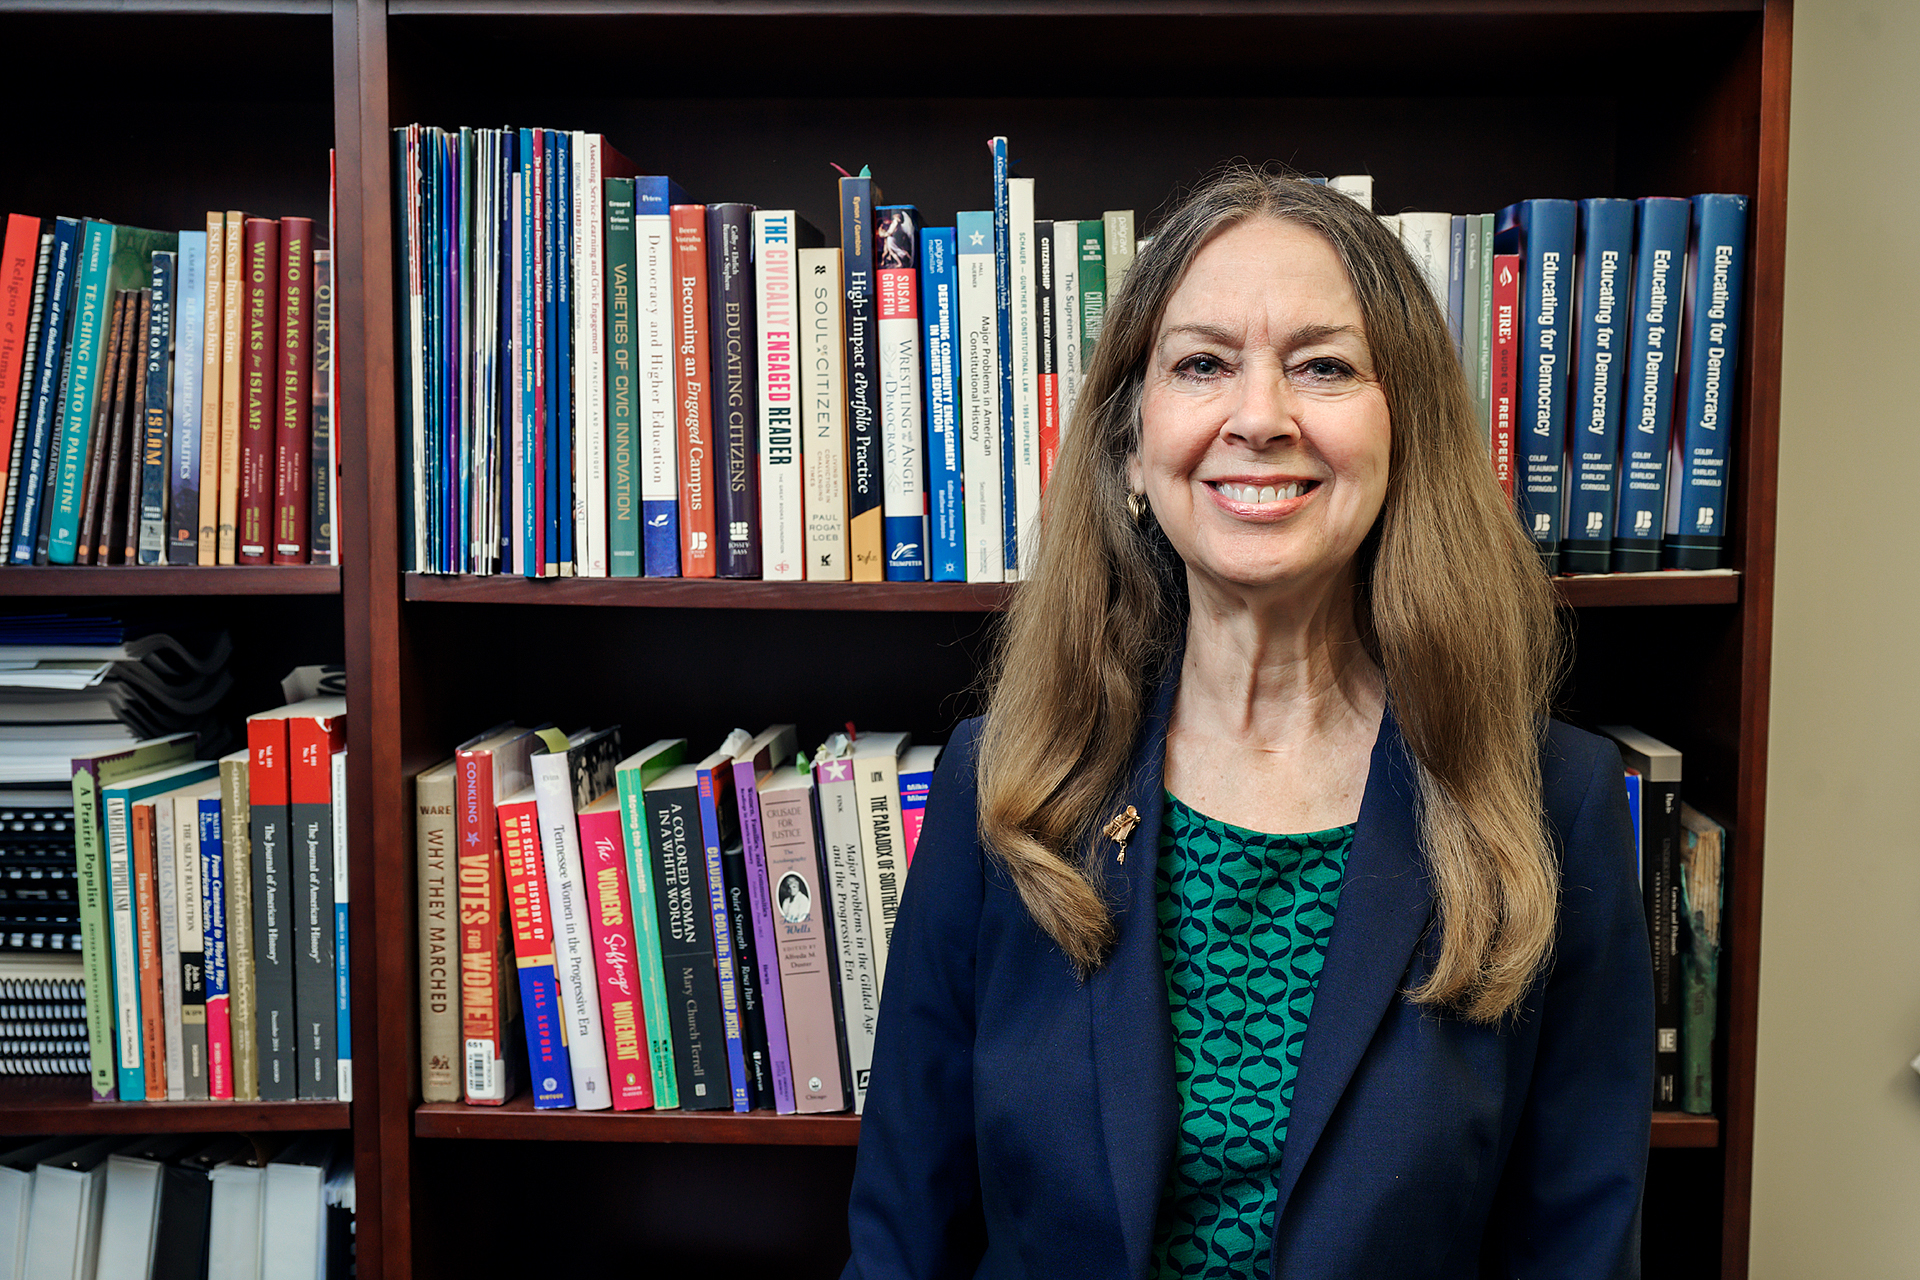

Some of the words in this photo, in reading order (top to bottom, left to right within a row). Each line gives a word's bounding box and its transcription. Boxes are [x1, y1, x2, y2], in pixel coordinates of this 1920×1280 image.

[588, 143, 597, 183] Assessing
[589, 185, 599, 257] Service-Learning
[764, 216, 787, 244] THE
[1118, 217, 1128, 255] palgrave
[288, 239, 300, 281] WHO
[591, 260, 599, 276] and
[646, 235, 662, 314] Democracy
[934, 239, 944, 273] palgrave
[1041, 237, 1050, 289] CITIZENSHIP
[591, 278, 599, 299] Civic
[614, 264, 628, 344] VARIETIES
[765, 250, 789, 326] CIVICALLY
[882, 273, 895, 315] GRIFFIN
[897, 275, 910, 312] SUSAN
[1538, 252, 1559, 325] Educating
[1595, 251, 1618, 324] Educating
[1646, 250, 1671, 322] Educating
[1708, 246, 1733, 319] Educating
[78, 284, 97, 361] TEACHING
[149, 266, 163, 372] ARMSTRONG
[286, 287, 300, 348] SPEAKS
[589, 303, 600, 354] Engagement
[651, 322, 663, 347] and
[681, 276, 697, 354] Becoming
[814, 287, 829, 343] SOUL
[851, 270, 869, 368] High-Impact
[930, 324, 940, 335] IN
[938, 284, 951, 340] DEEPENING
[980, 316, 991, 344] Major
[1499, 305, 1512, 343] FIRE's
[1710, 322, 1726, 344] for
[287, 353, 297, 366] for
[615, 349, 628, 370] OF
[725, 302, 742, 406] EDUCATING
[930, 337, 941, 371] HIGHER
[1540, 329, 1554, 350] for
[1596, 328, 1612, 349] for
[1648, 327, 1665, 348] for
[72, 365, 87, 412] PLATO
[648, 354, 664, 403] Higher
[685, 357, 697, 377] an
[767, 332, 790, 401] ENGAGED
[899, 338, 913, 428] WRESTLING
[940, 342, 953, 404] COMMUNITY
[969, 331, 982, 400] Constitutional
[983, 349, 991, 394] Problems
[1501, 382, 1508, 394] TO
[1700, 348, 1725, 430] Democracy
[285, 370, 297, 428] ISLAM?
[616, 376, 629, 416] CIVIC
[685, 381, 704, 444] Engaged
[816, 358, 830, 437] CITIZEN
[852, 372, 871, 431] ePortfolio
[932, 373, 943, 432] EDUCATION
[984, 398, 992, 406] in
[1045, 398, 1052, 406] TO
[1498, 397, 1508, 428] FREE
[1534, 354, 1553, 436] Democracy
[1589, 352, 1611, 435] Democracy
[1638, 352, 1663, 434] Democracy
[70, 416, 82, 433] IN
[145, 408, 163, 465] ISLAM
[769, 407, 792, 465] READER
[885, 381, 898, 464] DEMOCRACY
[943, 405, 956, 471] ENGAGEMENT
[969, 404, 983, 442] History
[984, 409, 993, 456] American
[652, 411, 665, 483] Education
[729, 411, 746, 491] CITIZENS
[856, 436, 871, 493] Practice
[901, 445, 914, 496] ANGEL
[1498, 433, 1509, 480] SPEECH
[60, 437, 80, 513] PALESTINE
[616, 422, 630, 520] INNOVATION
[687, 447, 703, 510] Campus
[80, 787, 91, 796] A
[420, 806, 451, 815] WARE
[466, 762, 478, 823] CONKLING
[671, 803, 682, 813] A
[871, 795, 887, 811] THE
[81, 802, 94, 850] Prairie
[108, 799, 126, 856] AMERICAN
[183, 823, 191, 839] THE
[520, 814, 531, 834] THE
[659, 809, 668, 823] IN
[661, 825, 671, 838] A
[872, 814, 893, 858] PARADOX
[184, 842, 192, 872] SILENT
[428, 829, 444, 870] WHY
[505, 817, 525, 877] WONDER
[524, 838, 536, 876] SECRET
[553, 824, 568, 878] Tennessee
[595, 837, 614, 861] The
[662, 840, 677, 886] WHITE
[672, 816, 689, 885] COLORED
[833, 846, 843, 867] and
[846, 844, 858, 877] Major
[877, 860, 894, 869] OF
[83, 854, 97, 908] Populist
[111, 861, 129, 912] POPULISM
[429, 877, 445, 919] THEY
[460, 854, 489, 924] VOTES
[528, 881, 542, 924] HISTORY
[561, 881, 574, 920] Women
[597, 867, 623, 926] WOMEN'S
[707, 847, 724, 911] CLAUDETTE
[835, 870, 845, 889] the
[185, 876, 194, 931] REVOLUTION
[513, 884, 531, 941] WOMAN
[668, 888, 682, 939] WORLD
[679, 888, 696, 943] WOMAN
[837, 893, 853, 956] Progressive
[850, 882, 864, 933] Problems
[467, 930, 481, 949] FOR
[534, 928, 544, 940] OF
[566, 923, 576, 933] in
[568, 937, 579, 954] the
[714, 914, 729, 956] COLVIN:
[856, 938, 864, 948] in
[430, 927, 446, 1013] MARCHED
[603, 934, 631, 995] Suffrage
[681, 967, 694, 995] Mary
[718, 957, 732, 979] TWICE
[845, 961, 854, 980] Era
[857, 953, 867, 969] the
[463, 951, 493, 1036] WOMEN
[534, 981, 546, 1008] JILL
[570, 957, 587, 1015] Progressive
[721, 980, 735, 1009] TOWARD
[860, 974, 873, 1010] Gilded
[536, 1015, 552, 1062] LEPORE
[578, 1018, 589, 1036] Era
[612, 1001, 639, 1060] MOVEMENT
[686, 1000, 700, 1040] Church
[724, 1011, 739, 1039] JUSTICE
[863, 1014, 874, 1035] Age
[691, 1042, 704, 1076] Terrell
